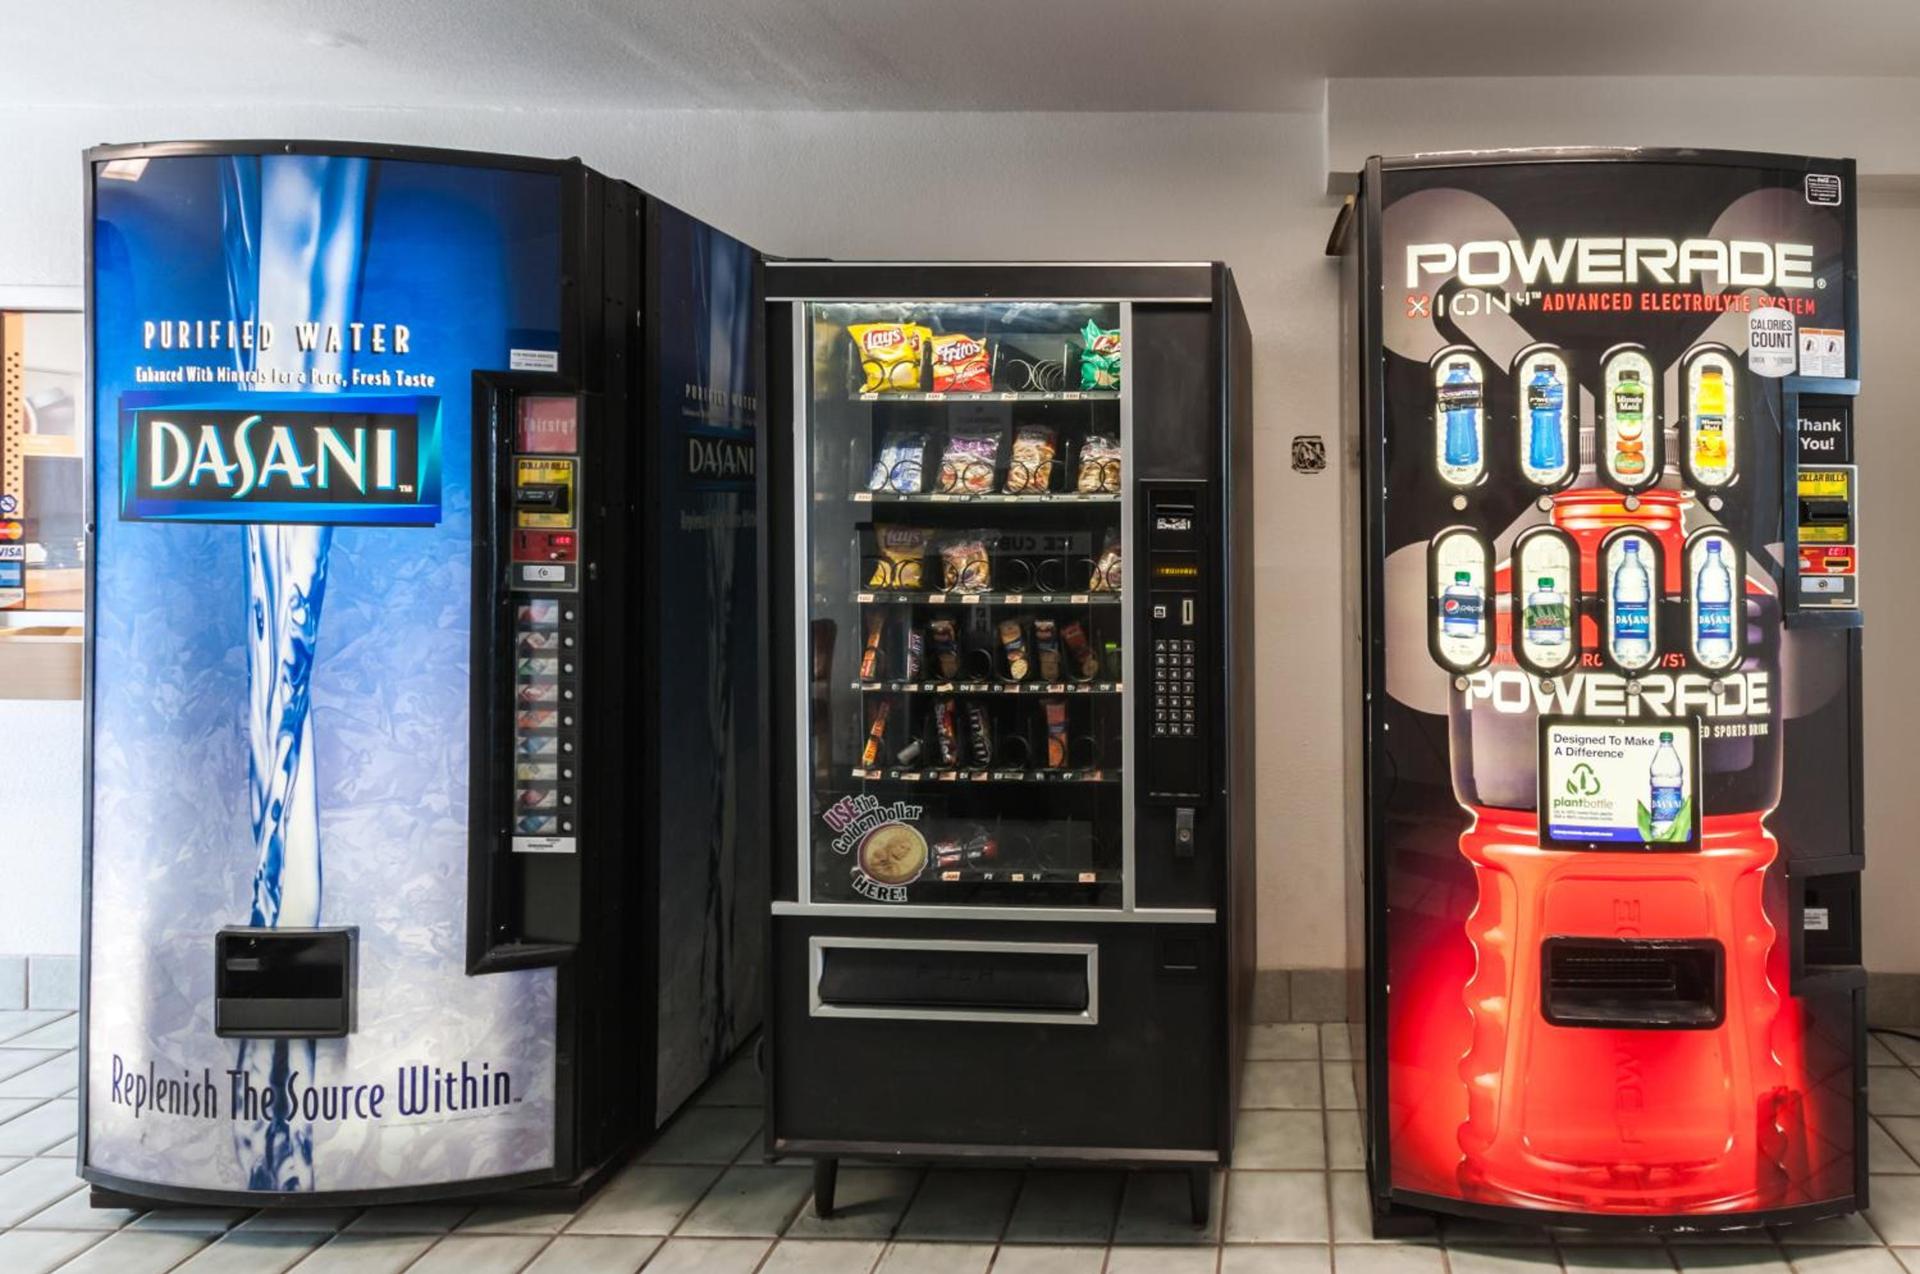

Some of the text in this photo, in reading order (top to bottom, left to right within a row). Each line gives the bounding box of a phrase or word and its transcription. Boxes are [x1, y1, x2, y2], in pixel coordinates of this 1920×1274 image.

[1406, 237, 1814, 289] POWERADE
[1543, 292, 1632, 312] ADVANCED
[1641, 292, 1750, 313] ELECTROLYTE
[1758, 296, 1815, 316] SYSTEM
[1751, 319, 1792, 331] CALORIES
[144, 320, 410, 354] PURIFIED WATER
[1752, 332, 1792, 348] COUNT
[937, 340, 981, 364] Fritos
[135, 366, 184, 384] Enhanced
[185, 366, 214, 384] With
[298, 373, 306, 385] a
[352, 369, 391, 387] Fresh
[396, 371, 435, 388] Taste
[1797, 418, 1842, 433] Thank
[1800, 437, 1835, 451] You!
[151, 415, 396, 499] DASANI
[1554, 734, 1655, 748] Designed To Make
[1714, 723, 1747, 738] SPORTS
[1749, 722, 1768, 737] DRINK
[1554, 747, 1624, 758] A Difference
[824, 795, 878, 831] USE the
[1553, 797, 1613, 811] plantbottle
[832, 801, 922, 854] Golden Dollar
[853, 876, 908, 902] HERE!
[111, 1053, 511, 1122] Replenish The Source Within
